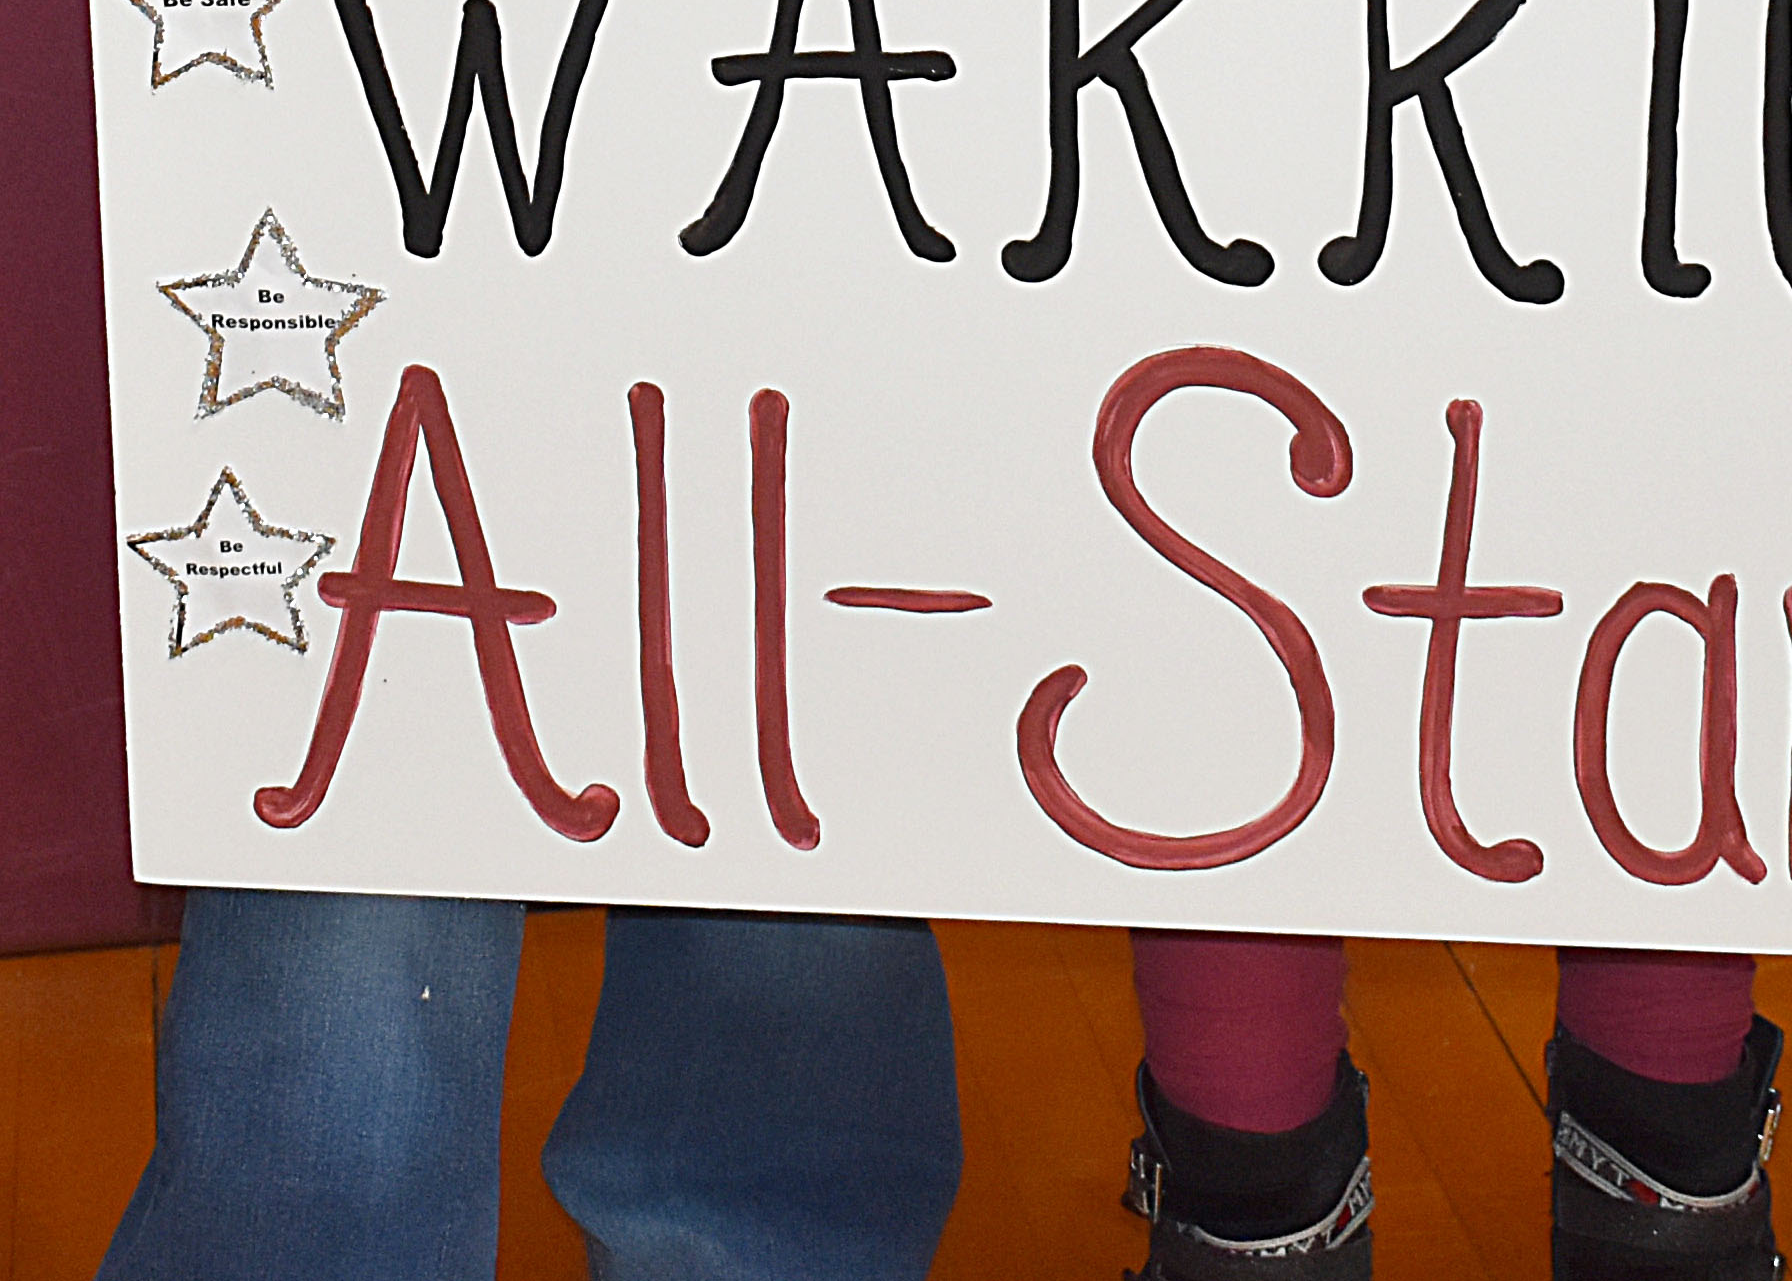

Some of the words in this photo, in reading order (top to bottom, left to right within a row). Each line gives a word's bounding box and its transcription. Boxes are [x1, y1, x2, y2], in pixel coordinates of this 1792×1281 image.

[258, 289, 285, 304] Be
[210, 313, 337, 333] Responsible
[219, 540, 244, 553] Be
[185, 561, 283, 579] Respectful
